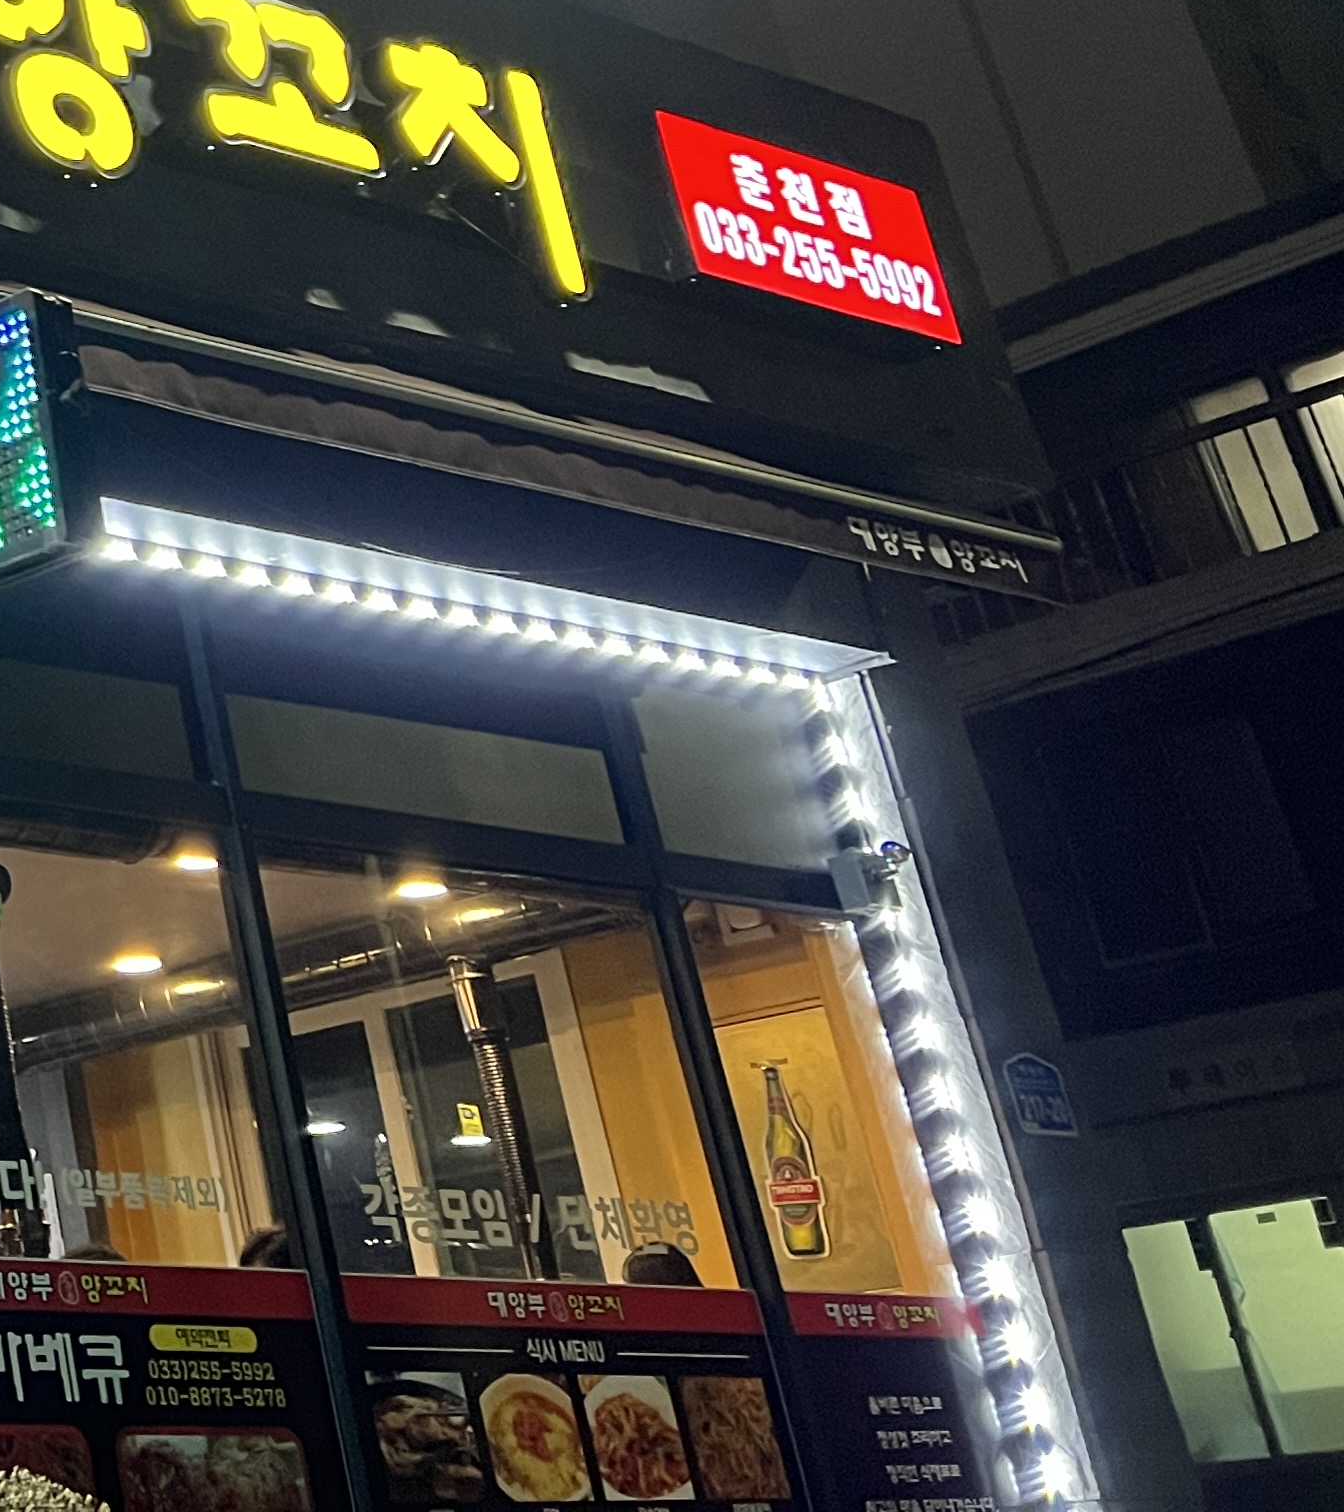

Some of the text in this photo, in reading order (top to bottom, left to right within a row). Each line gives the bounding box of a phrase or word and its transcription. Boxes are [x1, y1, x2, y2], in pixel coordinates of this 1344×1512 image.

[729, 153, 872, 240] 춘천점
[694, 201, 942, 316] 033-255-5992
[360, 1184, 514, 1245] 각종모임
[557, 1194, 700, 1256] 단체환영
[80, 1275, 149, 1304] 양꼬치
[487, 1291, 546, 1319] 대양부
[568, 1295, 625, 1321] 양꼬치
[526, 1338, 606, 1364] 식사 MENU
[148, 1358, 276, 1381] 033)255-5992
[145, 1385, 287, 1408] 010-8873-5278
